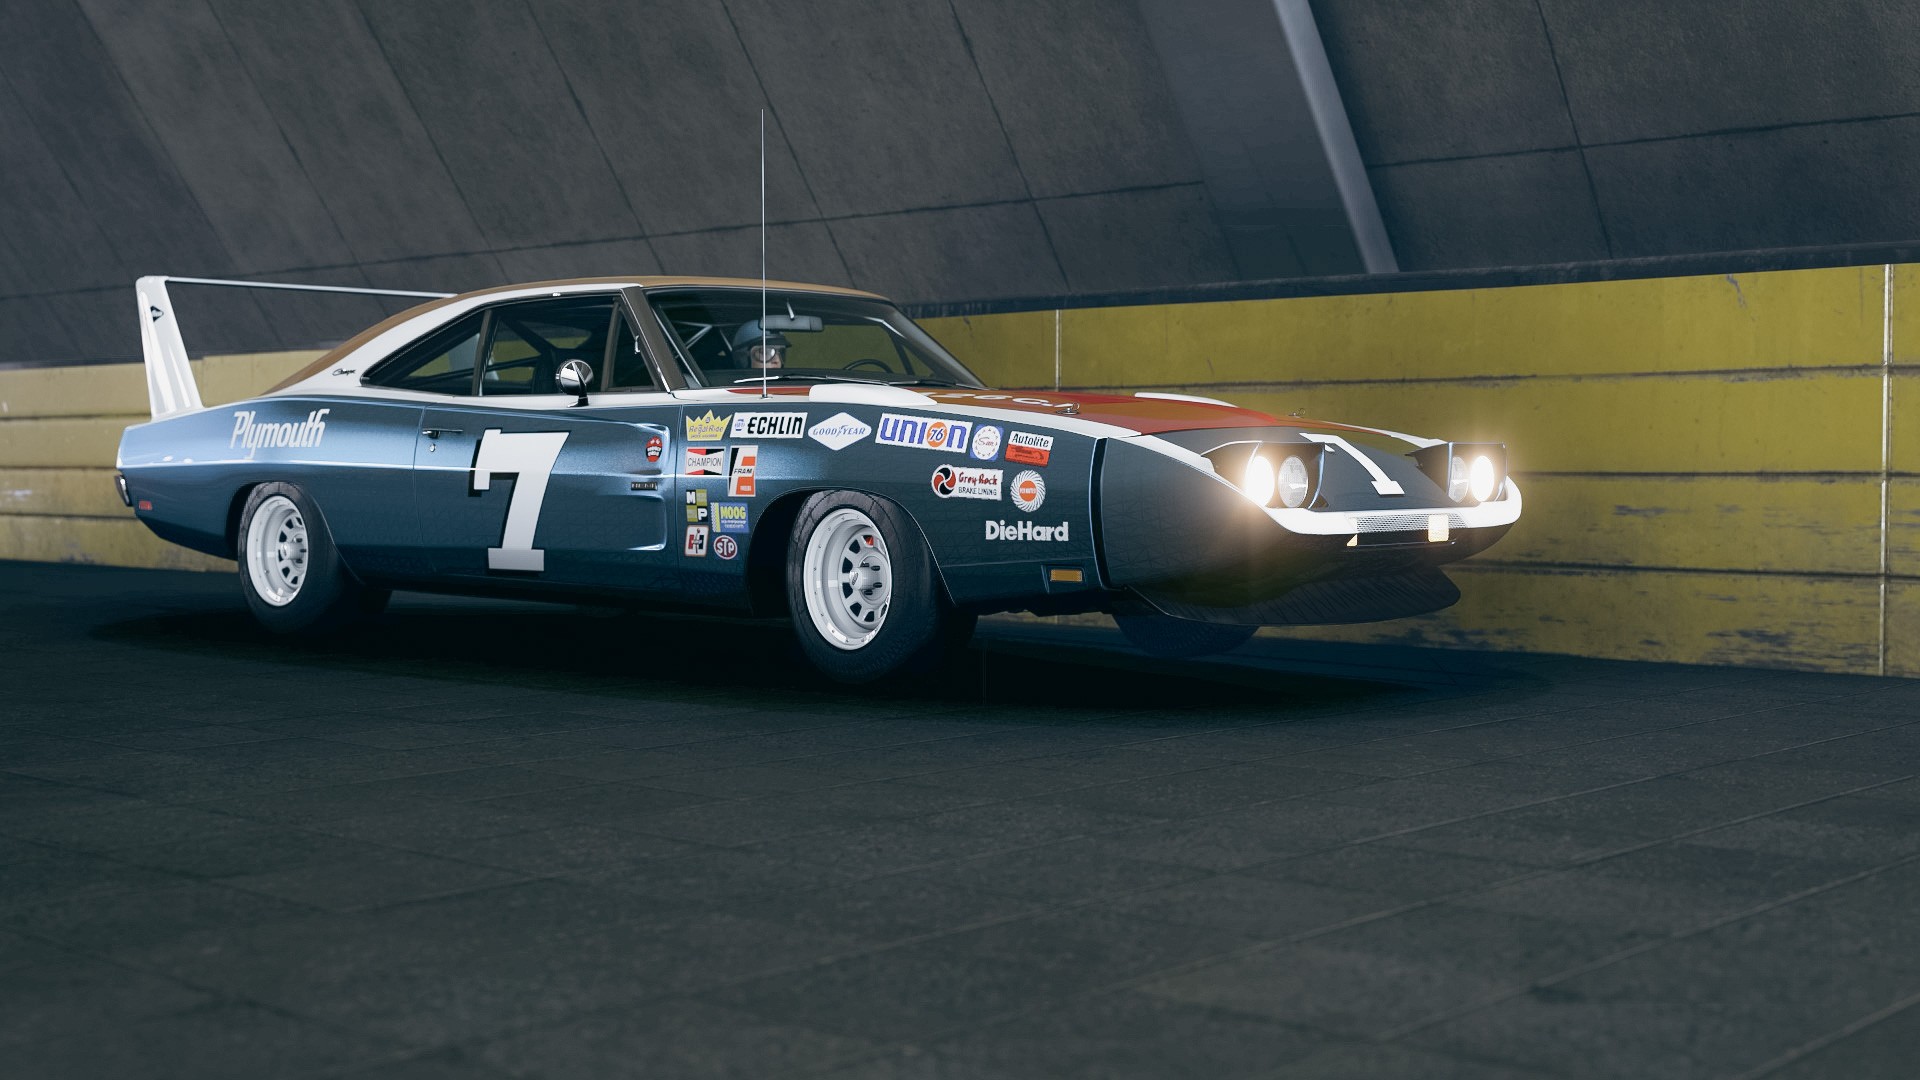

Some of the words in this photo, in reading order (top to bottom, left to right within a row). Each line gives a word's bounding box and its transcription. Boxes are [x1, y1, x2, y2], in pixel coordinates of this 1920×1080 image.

[747, 416, 803, 435] ECHLIN
[230, 408, 329, 460] Plymouth
[929, 428, 945, 442] 76
[1012, 433, 1050, 448] Autolite
[687, 457, 722, 468] CHAMPION
[958, 486, 977, 495] BRAKE
[978, 488, 997, 496] LINING
[472, 429, 570, 572] 7
[720, 506, 746, 519] MOOG
[985, 520, 1069, 542] DieHard
[716, 538, 735, 556] STP
